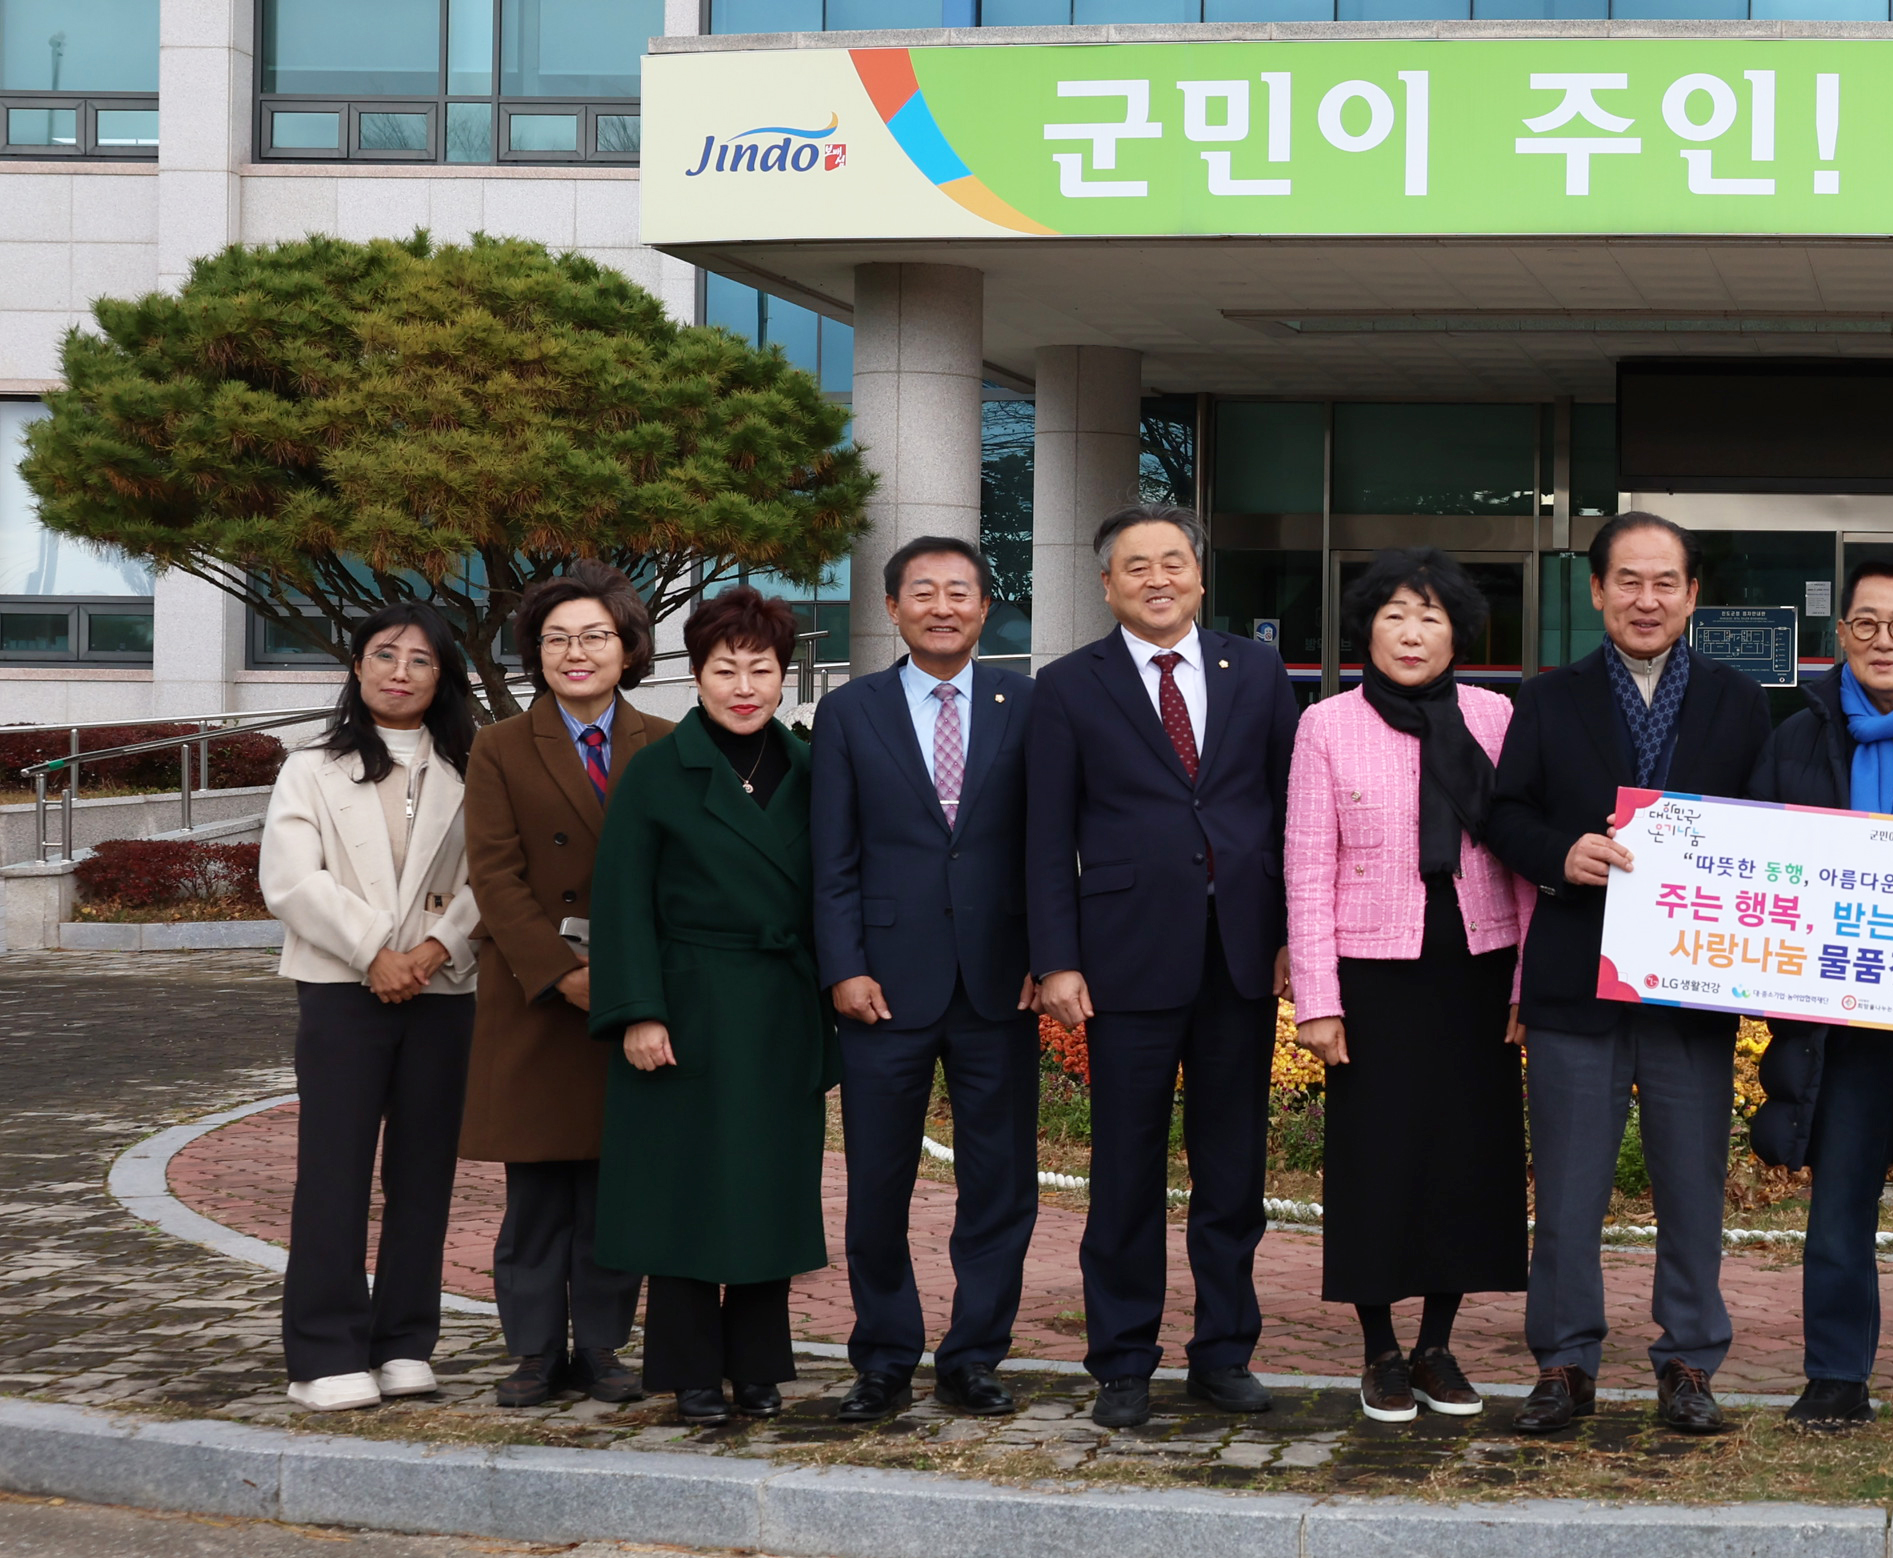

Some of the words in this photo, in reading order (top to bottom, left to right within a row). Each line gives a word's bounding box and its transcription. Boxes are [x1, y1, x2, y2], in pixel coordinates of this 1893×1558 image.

[1043, 70, 1428, 198] 군민이
[1515, 69, 1840, 197] 주인!
[685, 134, 820, 177] Jindo
[1649, 801, 1702, 825] 대한민국
[1648, 823, 1706, 847] 온기나눔
[1683, 852, 1756, 880] “따뜻한
[1764, 861, 1809, 888] 동행,
[1655, 882, 1724, 922] 주는
[1735, 889, 1814, 935] 행복,
[1669, 929, 1808, 977] 사랑나눔
[1661, 977, 1679, 989] LG
[1680, 979, 1721, 994] 생활건강
